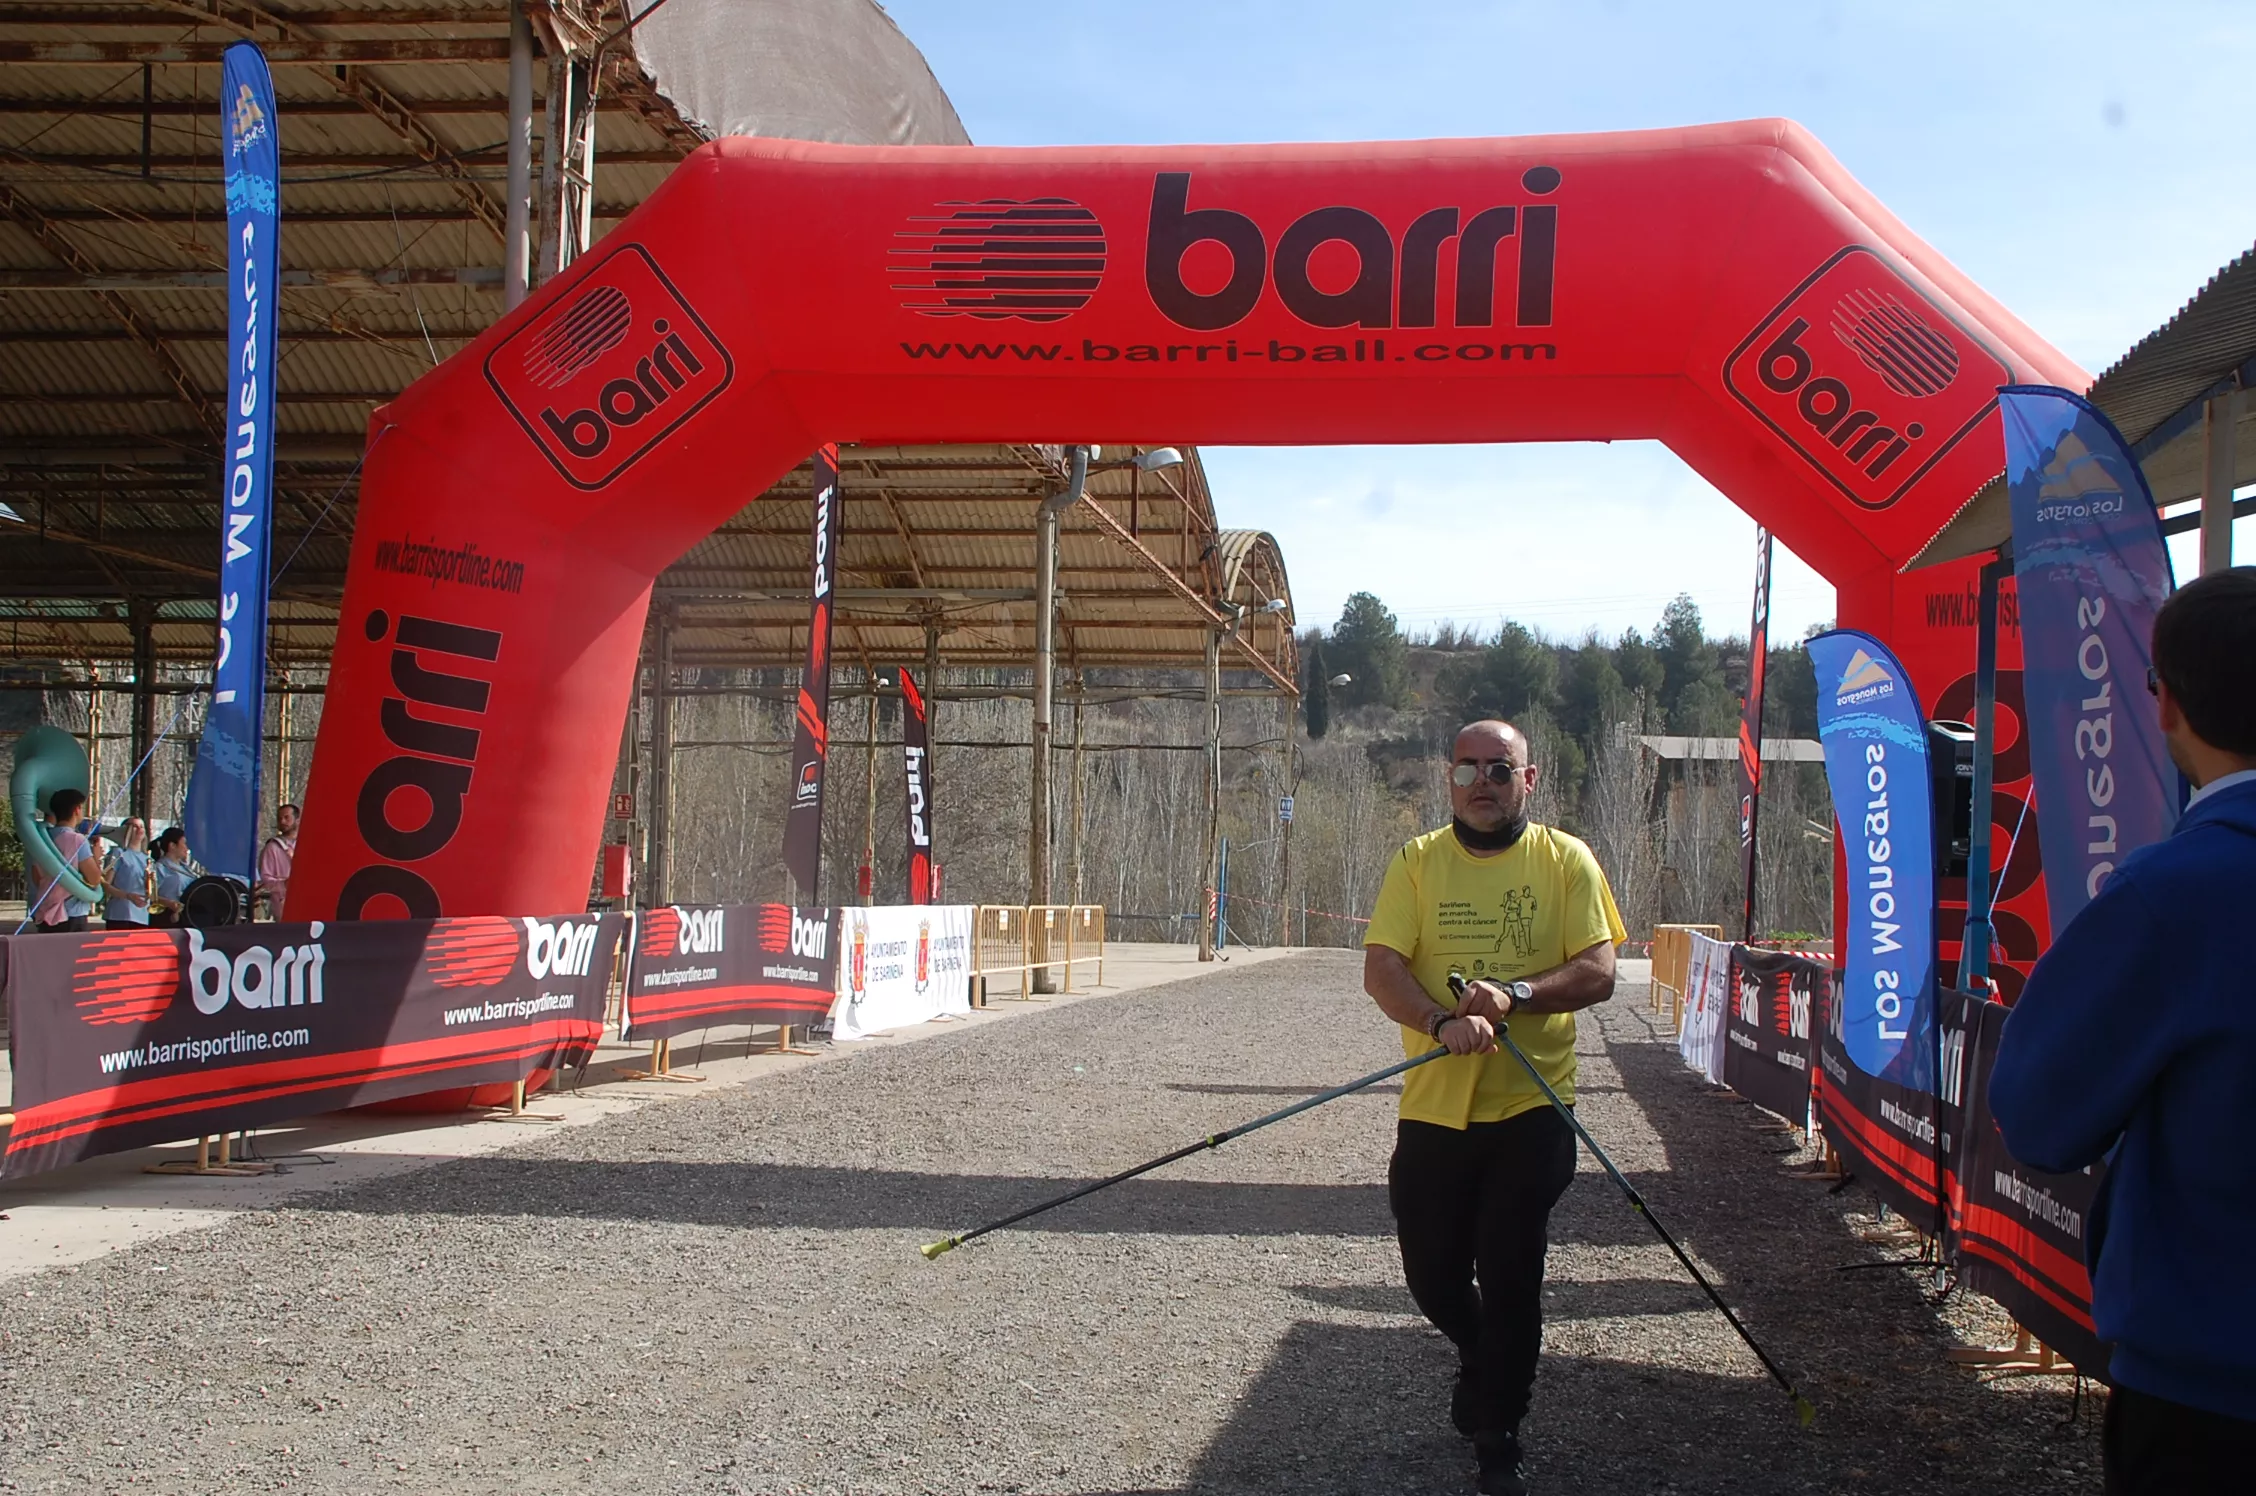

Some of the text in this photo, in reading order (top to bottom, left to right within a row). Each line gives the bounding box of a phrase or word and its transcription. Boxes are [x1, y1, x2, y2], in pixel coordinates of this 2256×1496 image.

[1145, 166, 1562, 332] barri
[900, 338, 1557, 362] www.barri-ball.com
[539, 318, 705, 459] barri
[1756, 316, 1925, 482] barri
[374, 532, 525, 595] www.barrisportline.com
[522, 912, 601, 980] barri
[671, 904, 724, 955] barri
[791, 906, 829, 959] barri
[871, 941, 907, 958] AYUNTAMIENTO
[185, 921, 325, 1015] barri
[872, 966, 880, 982] DE
[100, 1026, 309, 1073] www.barrisportline.com
[1994, 1169, 2081, 1240] www.barrisportline.com
